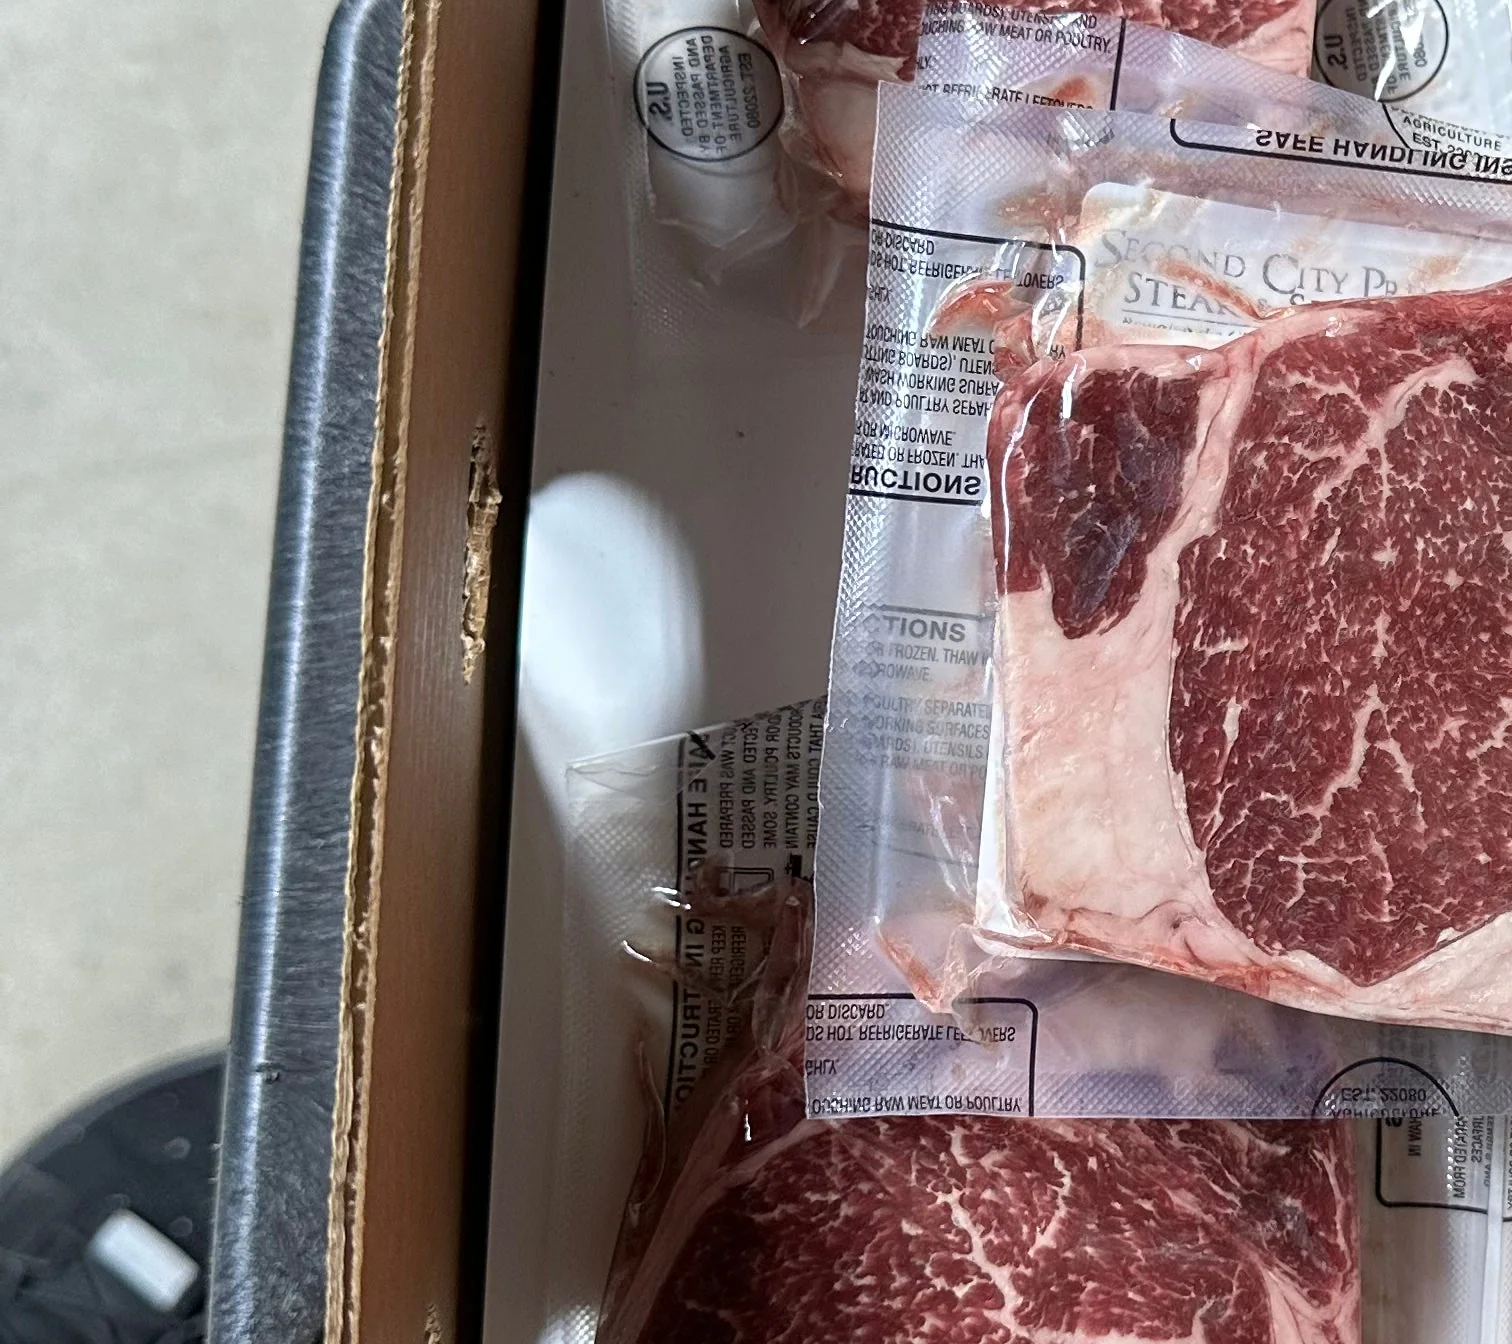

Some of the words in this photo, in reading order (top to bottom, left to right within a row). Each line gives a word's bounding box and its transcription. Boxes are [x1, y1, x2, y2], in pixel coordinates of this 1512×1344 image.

[999, 25, 1032, 42] MEAT
[1034, 28, 1053, 42] OR
[1402, 115, 1503, 152] AGRICULTURE
[1093, 227, 1247, 279] SECOND
[1261, 253, 1350, 295] CITY
[882, 614, 967, 643] TIONS
[942, 647, 979, 666] THAW
